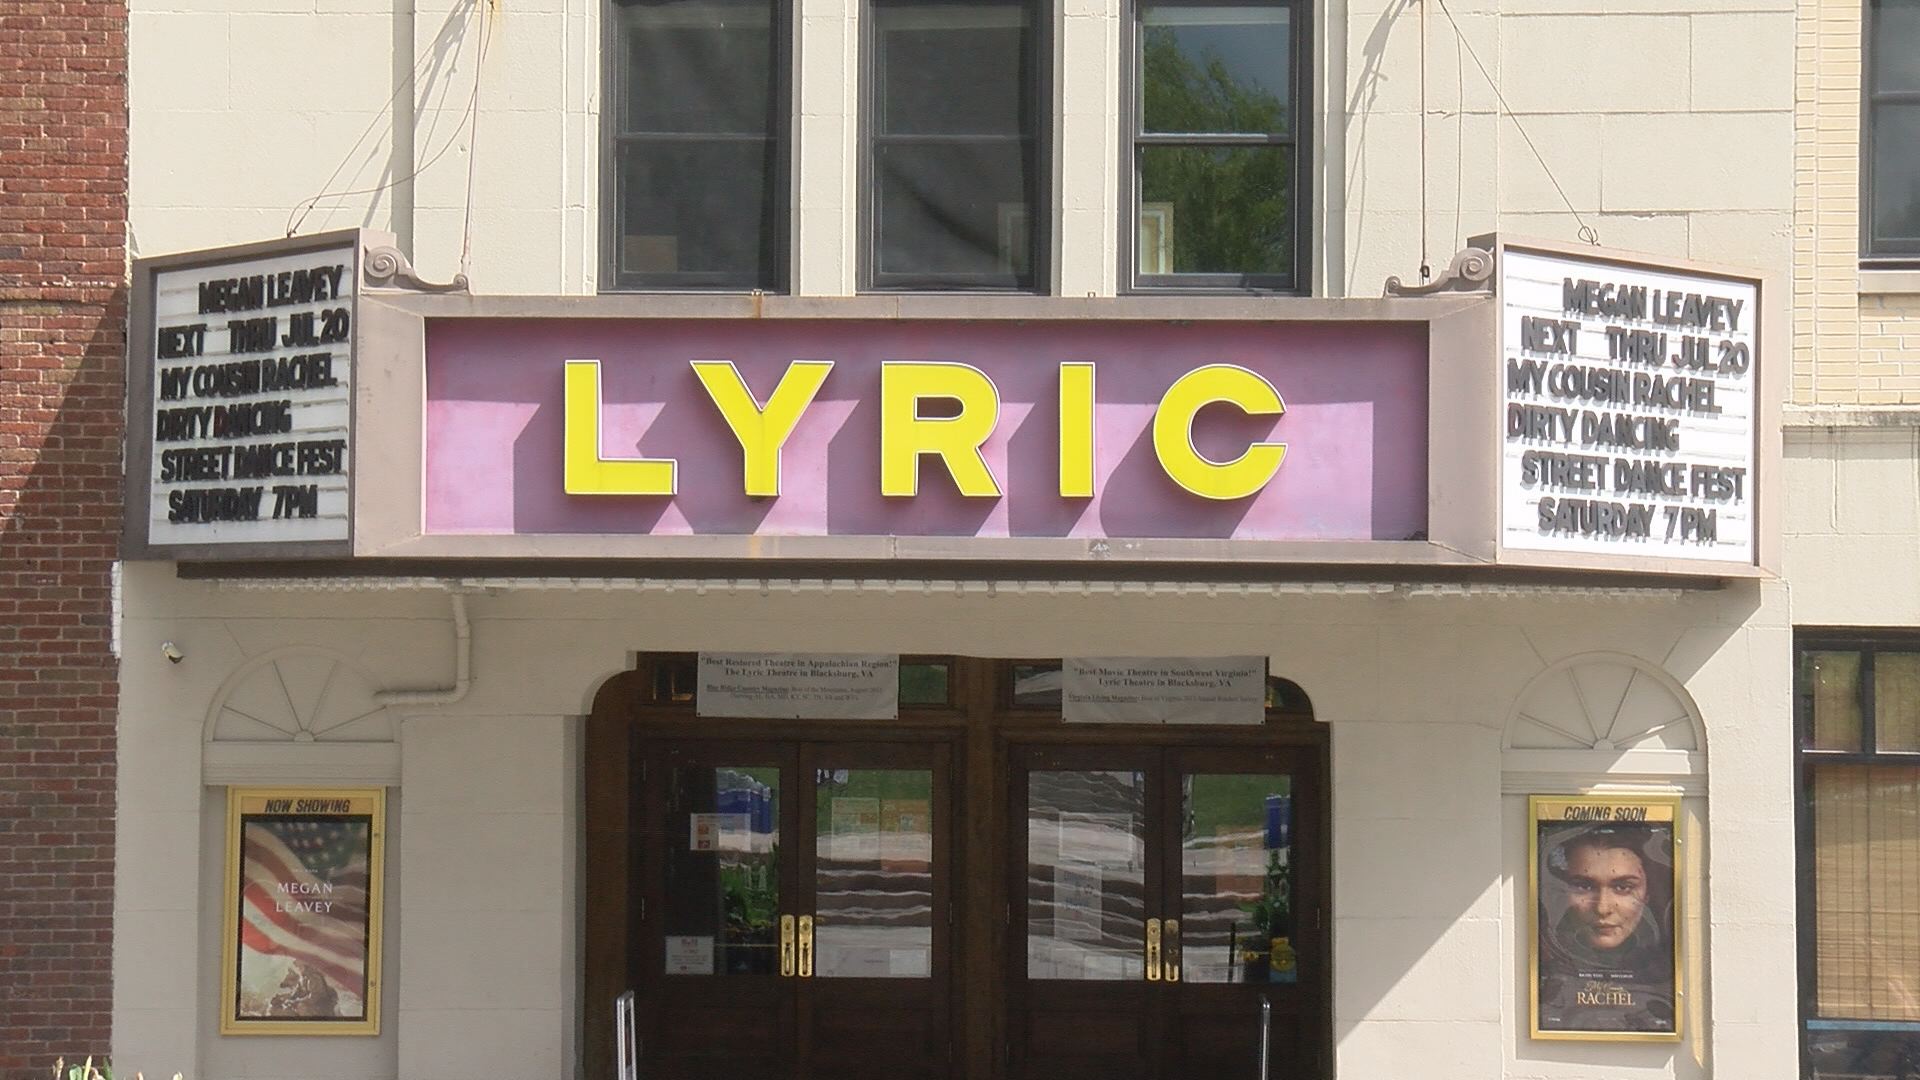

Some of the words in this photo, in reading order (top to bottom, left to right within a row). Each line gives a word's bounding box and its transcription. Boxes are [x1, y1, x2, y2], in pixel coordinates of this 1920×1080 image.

[199, 275, 264, 314] MEGAN
[267, 265, 344, 307] LEAVEY
[1563, 278, 1647, 320] MEGAN
[1653, 289, 1744, 331] LEAVEY
[158, 324, 207, 359] NEXT
[228, 317, 276, 353] THRU
[1521, 316, 1581, 354] NEXT
[1606, 326, 1667, 367] THRU
[161, 367, 193, 399] MY
[193, 360, 260, 397] COUSIN
[261, 353, 337, 392] RACHEL
[1507, 359, 1548, 395] MY
[1548, 364, 1630, 405] COUSIN
[1633, 372, 1722, 413] RACHEL
[157, 406, 213, 441] DIRTY
[214, 400, 291, 439] DANCING
[564, 359, 1288, 500] LYRIC
[1507, 403, 1579, 444] DIRTY
[1581, 410, 1679, 451] DANCING
[161, 446, 232, 481] STREET
[235, 443, 295, 478] DANCE
[298, 440, 347, 474] FEST
[1522, 451, 1609, 490] STREET
[1614, 459, 1687, 495] DANCE
[1691, 464, 1746, 500] FEST
[169, 487, 263, 523] SATURDAY
[1539, 498, 1655, 537] SATURDAY
[726, 658, 761, 667] Restored
[765, 659, 795, 667] Theatre
[808, 660, 858, 669] Appalachian
[742, 669, 763, 677] Lyric
[767, 669, 797, 677] Theatre
[811, 670, 858, 678] Blacksburg,
[1099, 668, 1124, 676] Movie
[1127, 669, 1158, 677] Theatre
[1170, 669, 1213, 677] Southwest
[1099, 678, 1120, 687] Lyric
[265, 800, 293, 812] NOW
[296, 800, 350, 812] SHOWING
[1564, 806, 1611, 820] COMING
[1615, 807, 1647, 821] SOON
[276, 882, 332, 893] MEGAN
[276, 902, 332, 912] LEAVEY
[1577, 992, 1635, 1005] RACHEL
